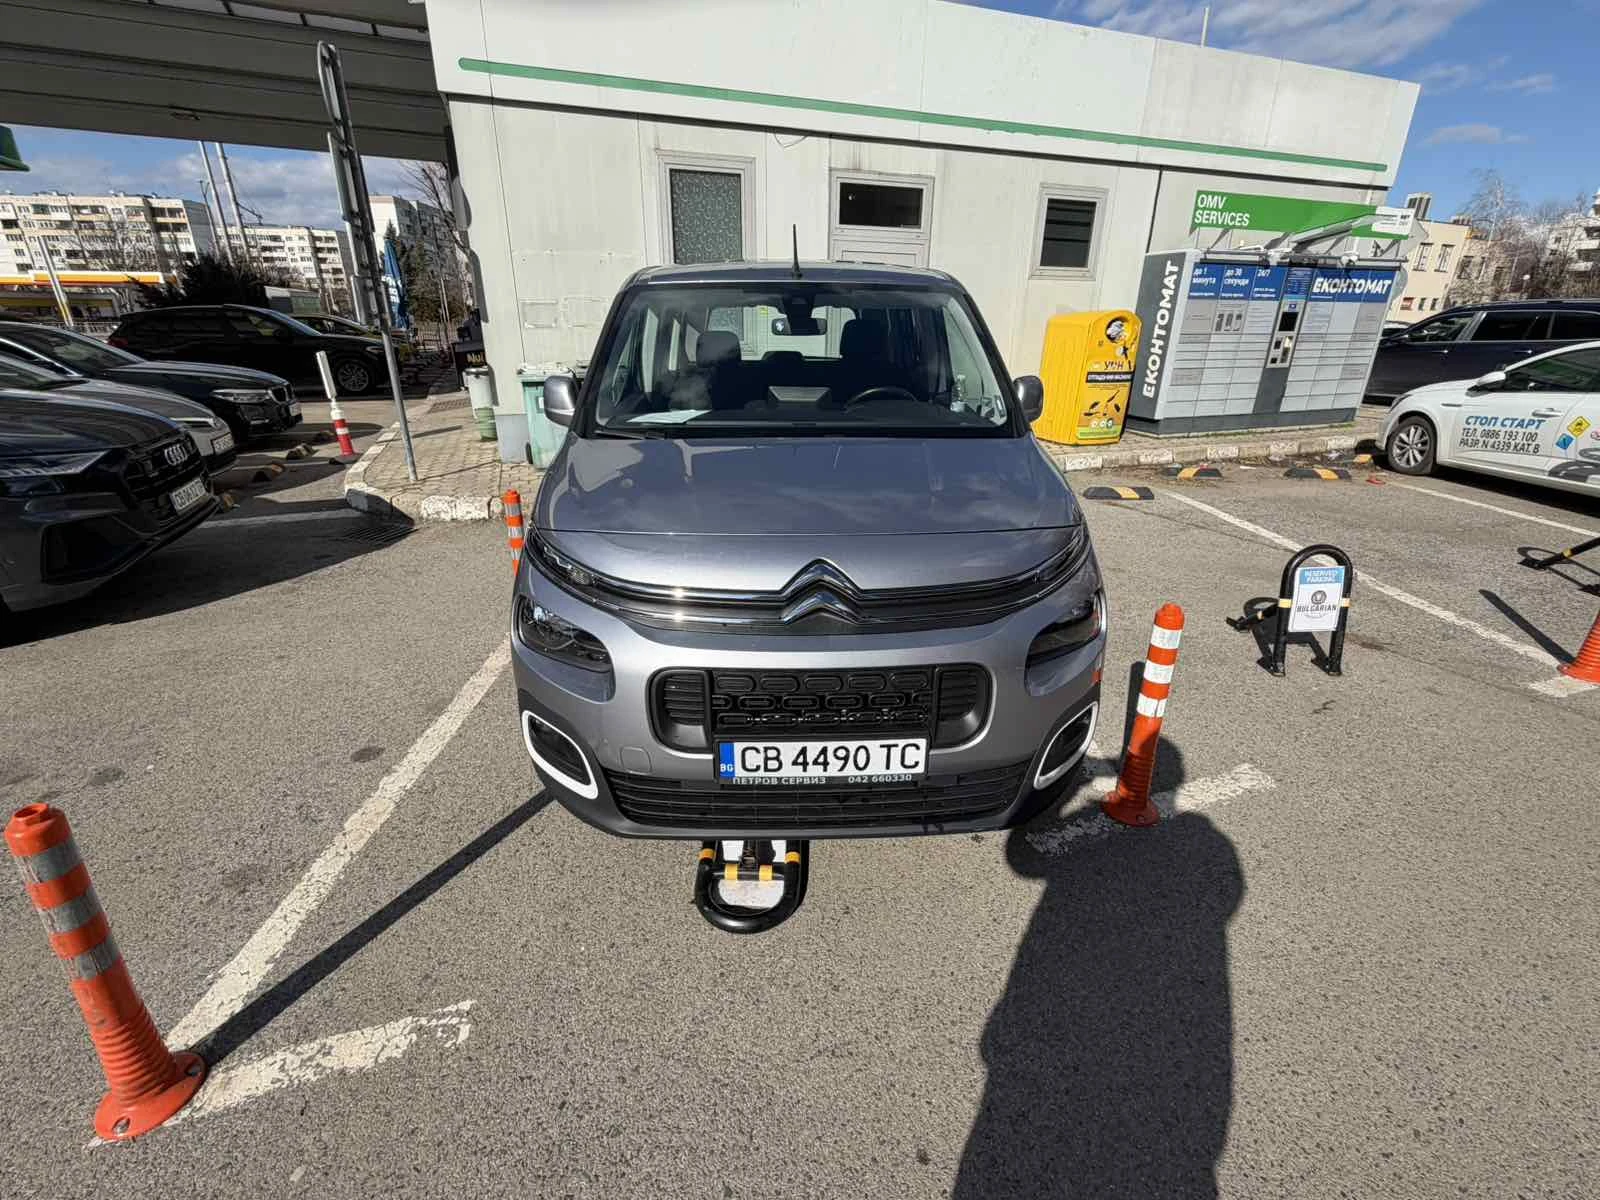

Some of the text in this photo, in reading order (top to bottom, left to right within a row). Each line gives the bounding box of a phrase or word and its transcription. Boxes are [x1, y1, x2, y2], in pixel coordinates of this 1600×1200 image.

[1197, 193, 1227, 209] OMV
[1194, 210, 1251, 227] SERVICES
[1311, 277, 1393, 295] ЕКОНТОМАТ
[1142, 260, 1180, 399] ЕКОНТОМАТ
[1465, 415, 1547, 430] СТОП СТАРТ
[1461, 427, 1538, 442] ТЕЛ. 0886 193 100
[1459, 438, 1479, 448] РАЗР.
[1489, 440, 1512, 452] 4339
[1514, 442, 1531, 453] КАТ.
[719, 743, 921, 773] BG CB 4490 TC
[732, 774, 912, 785] ПЕТРОВ СЕРВИЗ 042 660330
